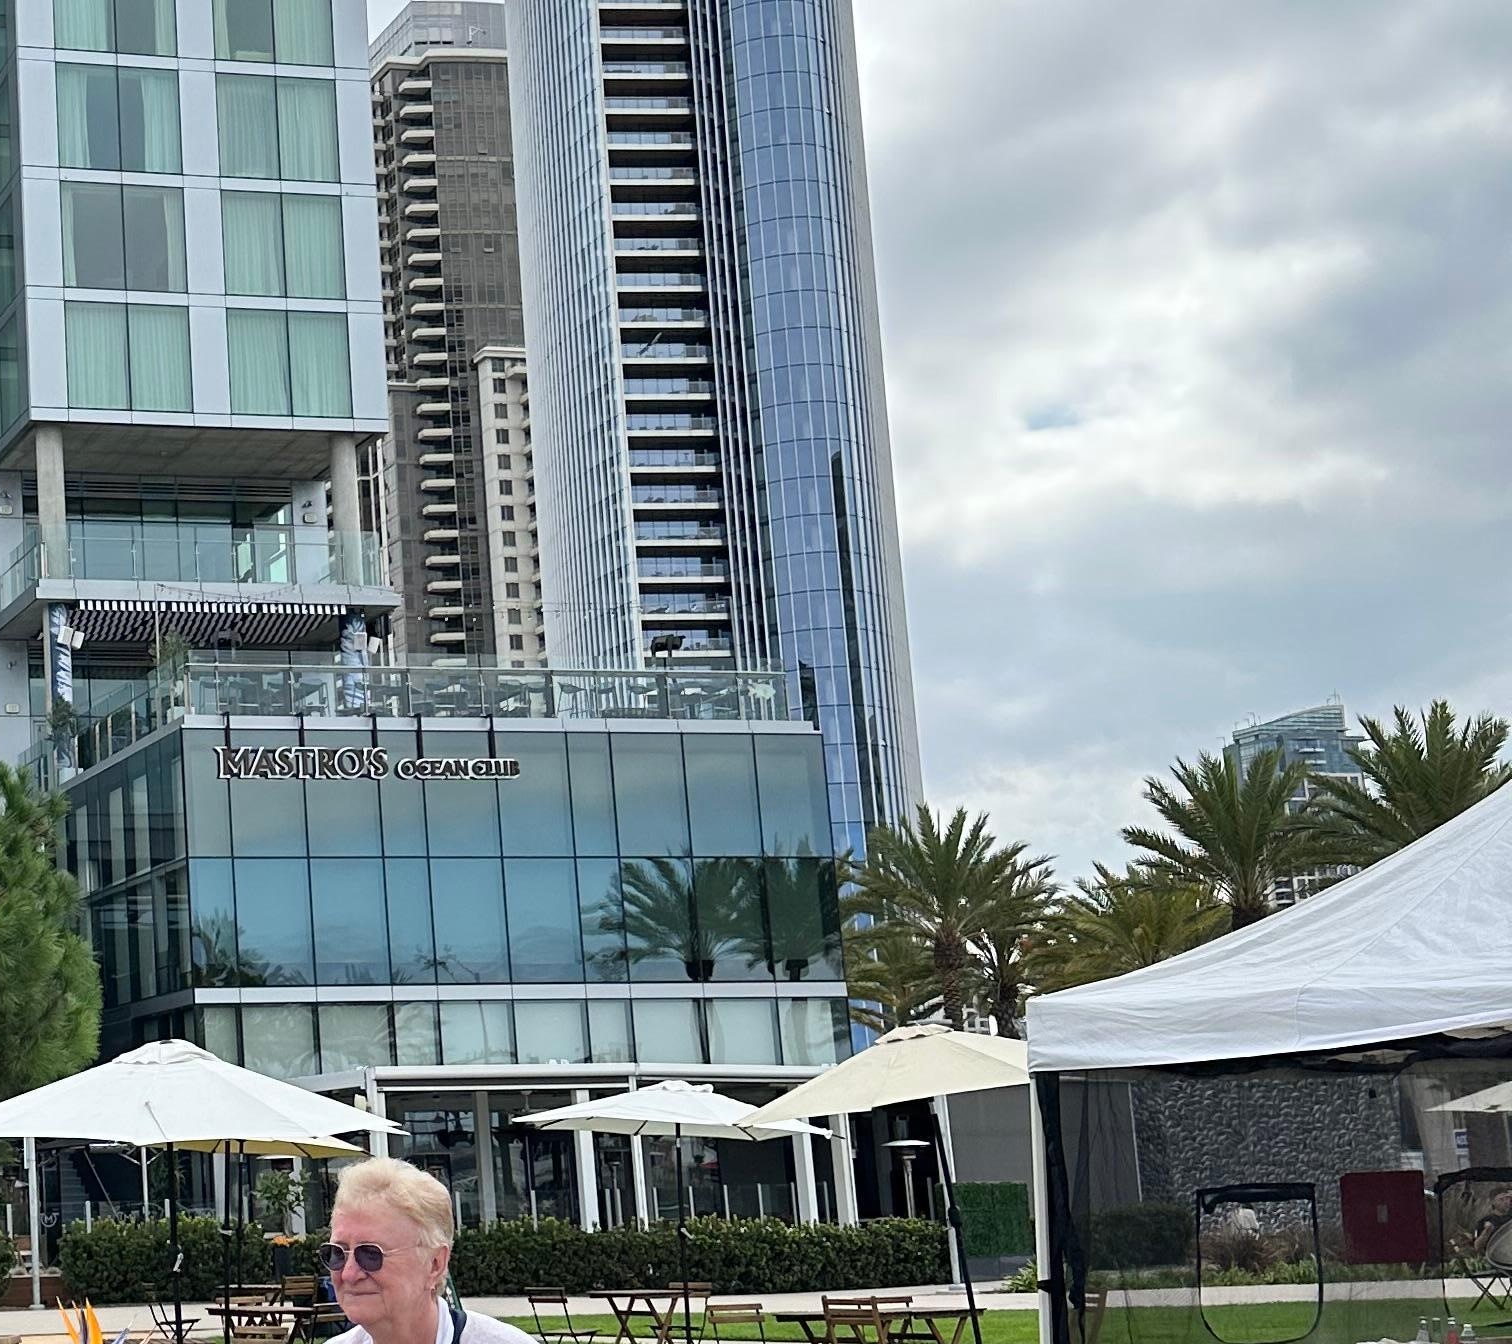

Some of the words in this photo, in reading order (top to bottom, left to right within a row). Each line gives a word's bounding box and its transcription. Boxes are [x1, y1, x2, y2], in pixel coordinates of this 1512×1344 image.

[215, 746, 389, 779] MASTRO'S
[396, 758, 469, 780] OCEAN
[469, 758, 520, 780] CLUB
